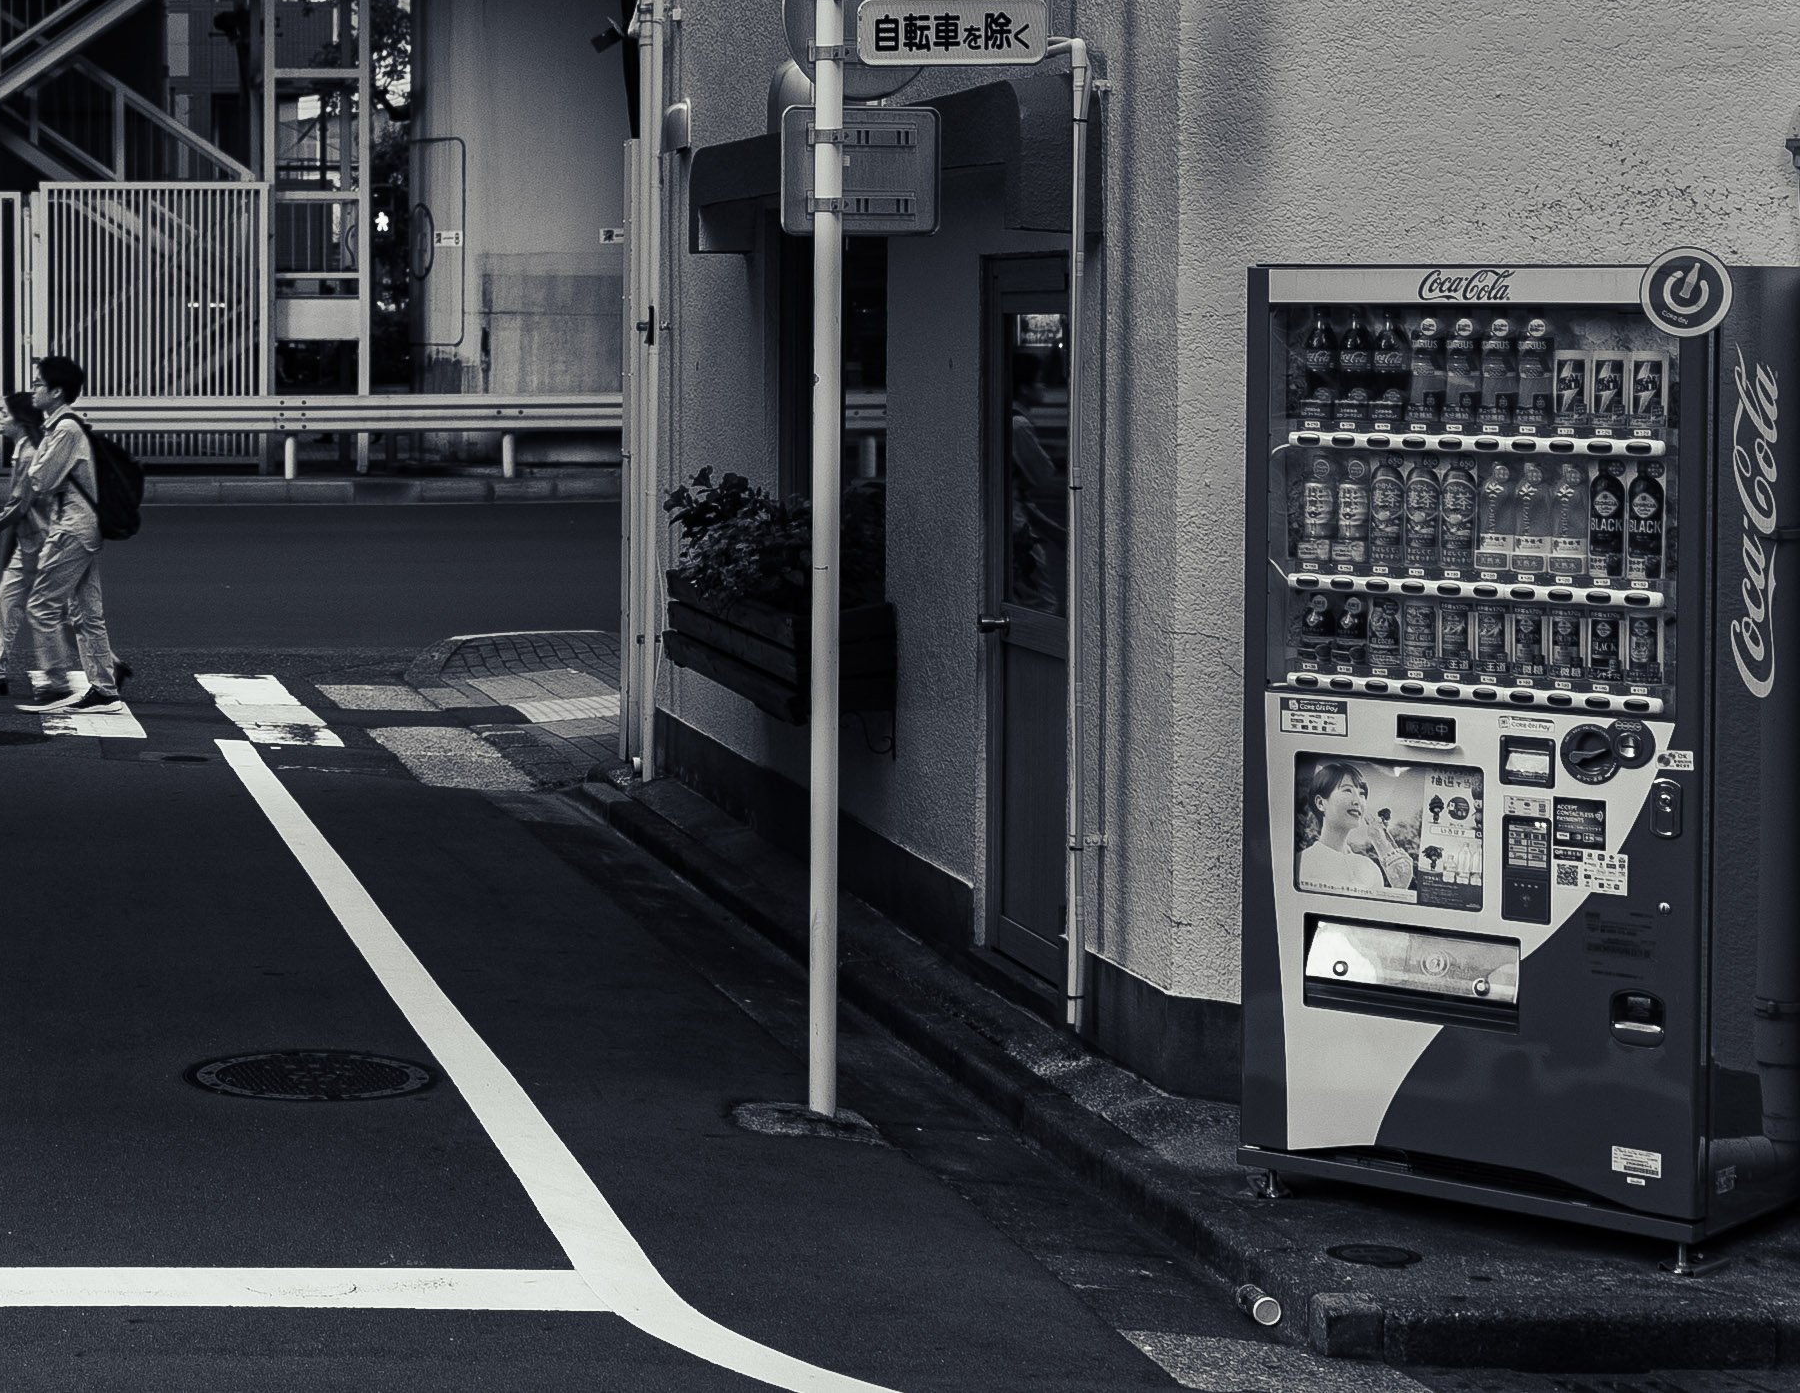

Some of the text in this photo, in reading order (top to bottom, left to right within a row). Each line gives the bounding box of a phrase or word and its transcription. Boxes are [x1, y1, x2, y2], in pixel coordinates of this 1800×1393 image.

[875, 12, 1030, 53] 自転車を除く
[1418, 270, 1515, 301] Coca-Cola
[1590, 517, 1623, 532] BLACK
[1628, 519, 1662, 534] BLACK
[1731, 341, 1778, 698] Coca-Cola
[1405, 721, 1449, 736] 販売中
